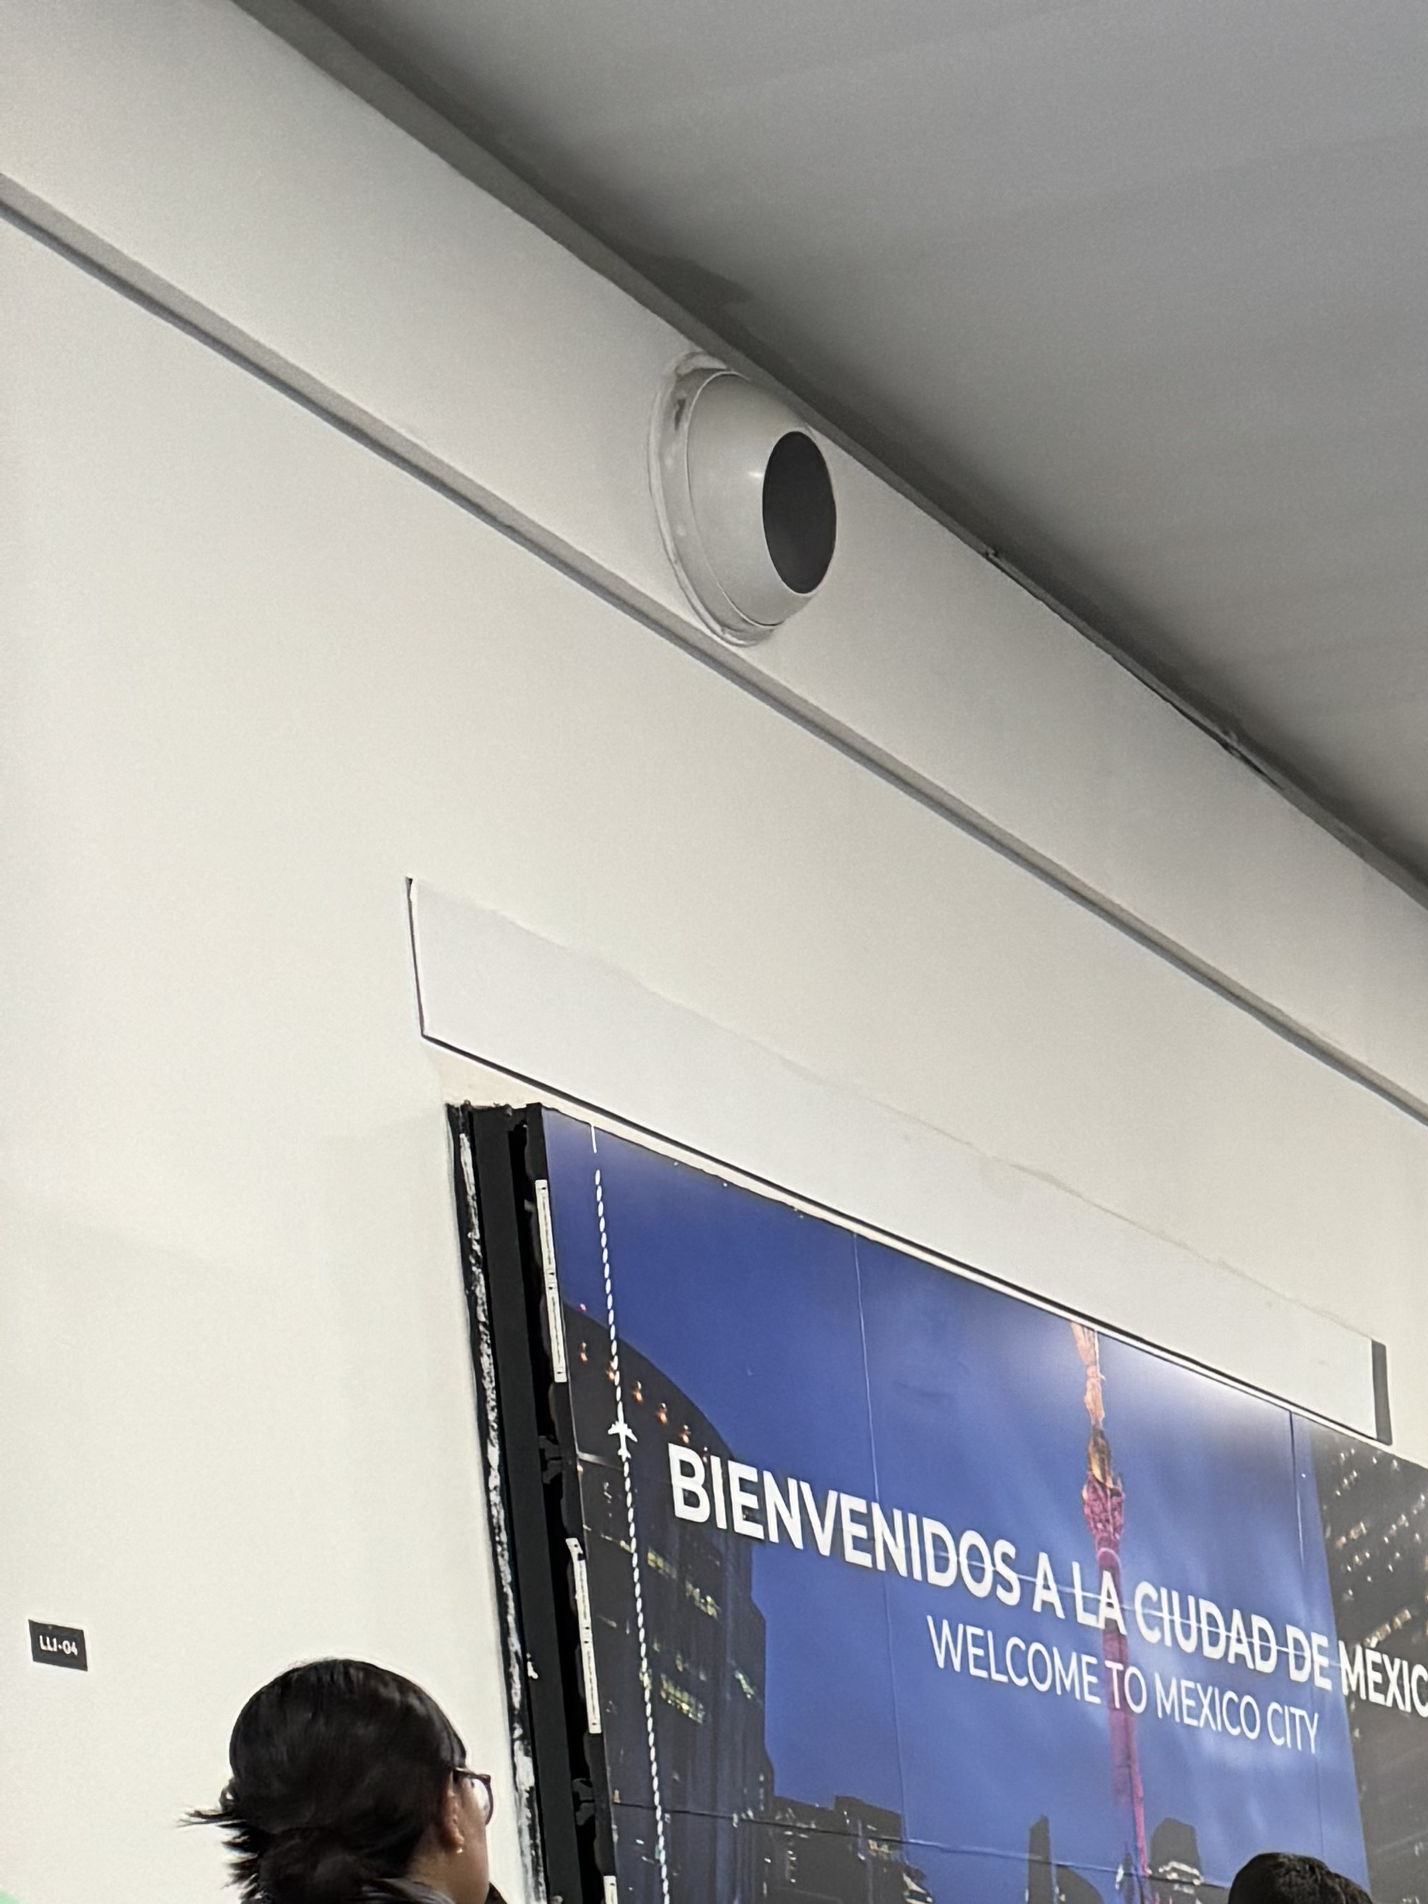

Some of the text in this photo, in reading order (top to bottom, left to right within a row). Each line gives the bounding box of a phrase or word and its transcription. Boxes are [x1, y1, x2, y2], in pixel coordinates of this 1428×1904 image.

[668, 1442, 1021, 1606] BIENVENIDOS
[1033, 1552, 1064, 1619] A
[1072, 1560, 1127, 1635] LA
[1135, 1580, 1278, 1675] CIUDAD
[1286, 1623, 1332, 1691] DE
[926, 1615, 1319, 1755] WELCOME TO MEXICO CITY
